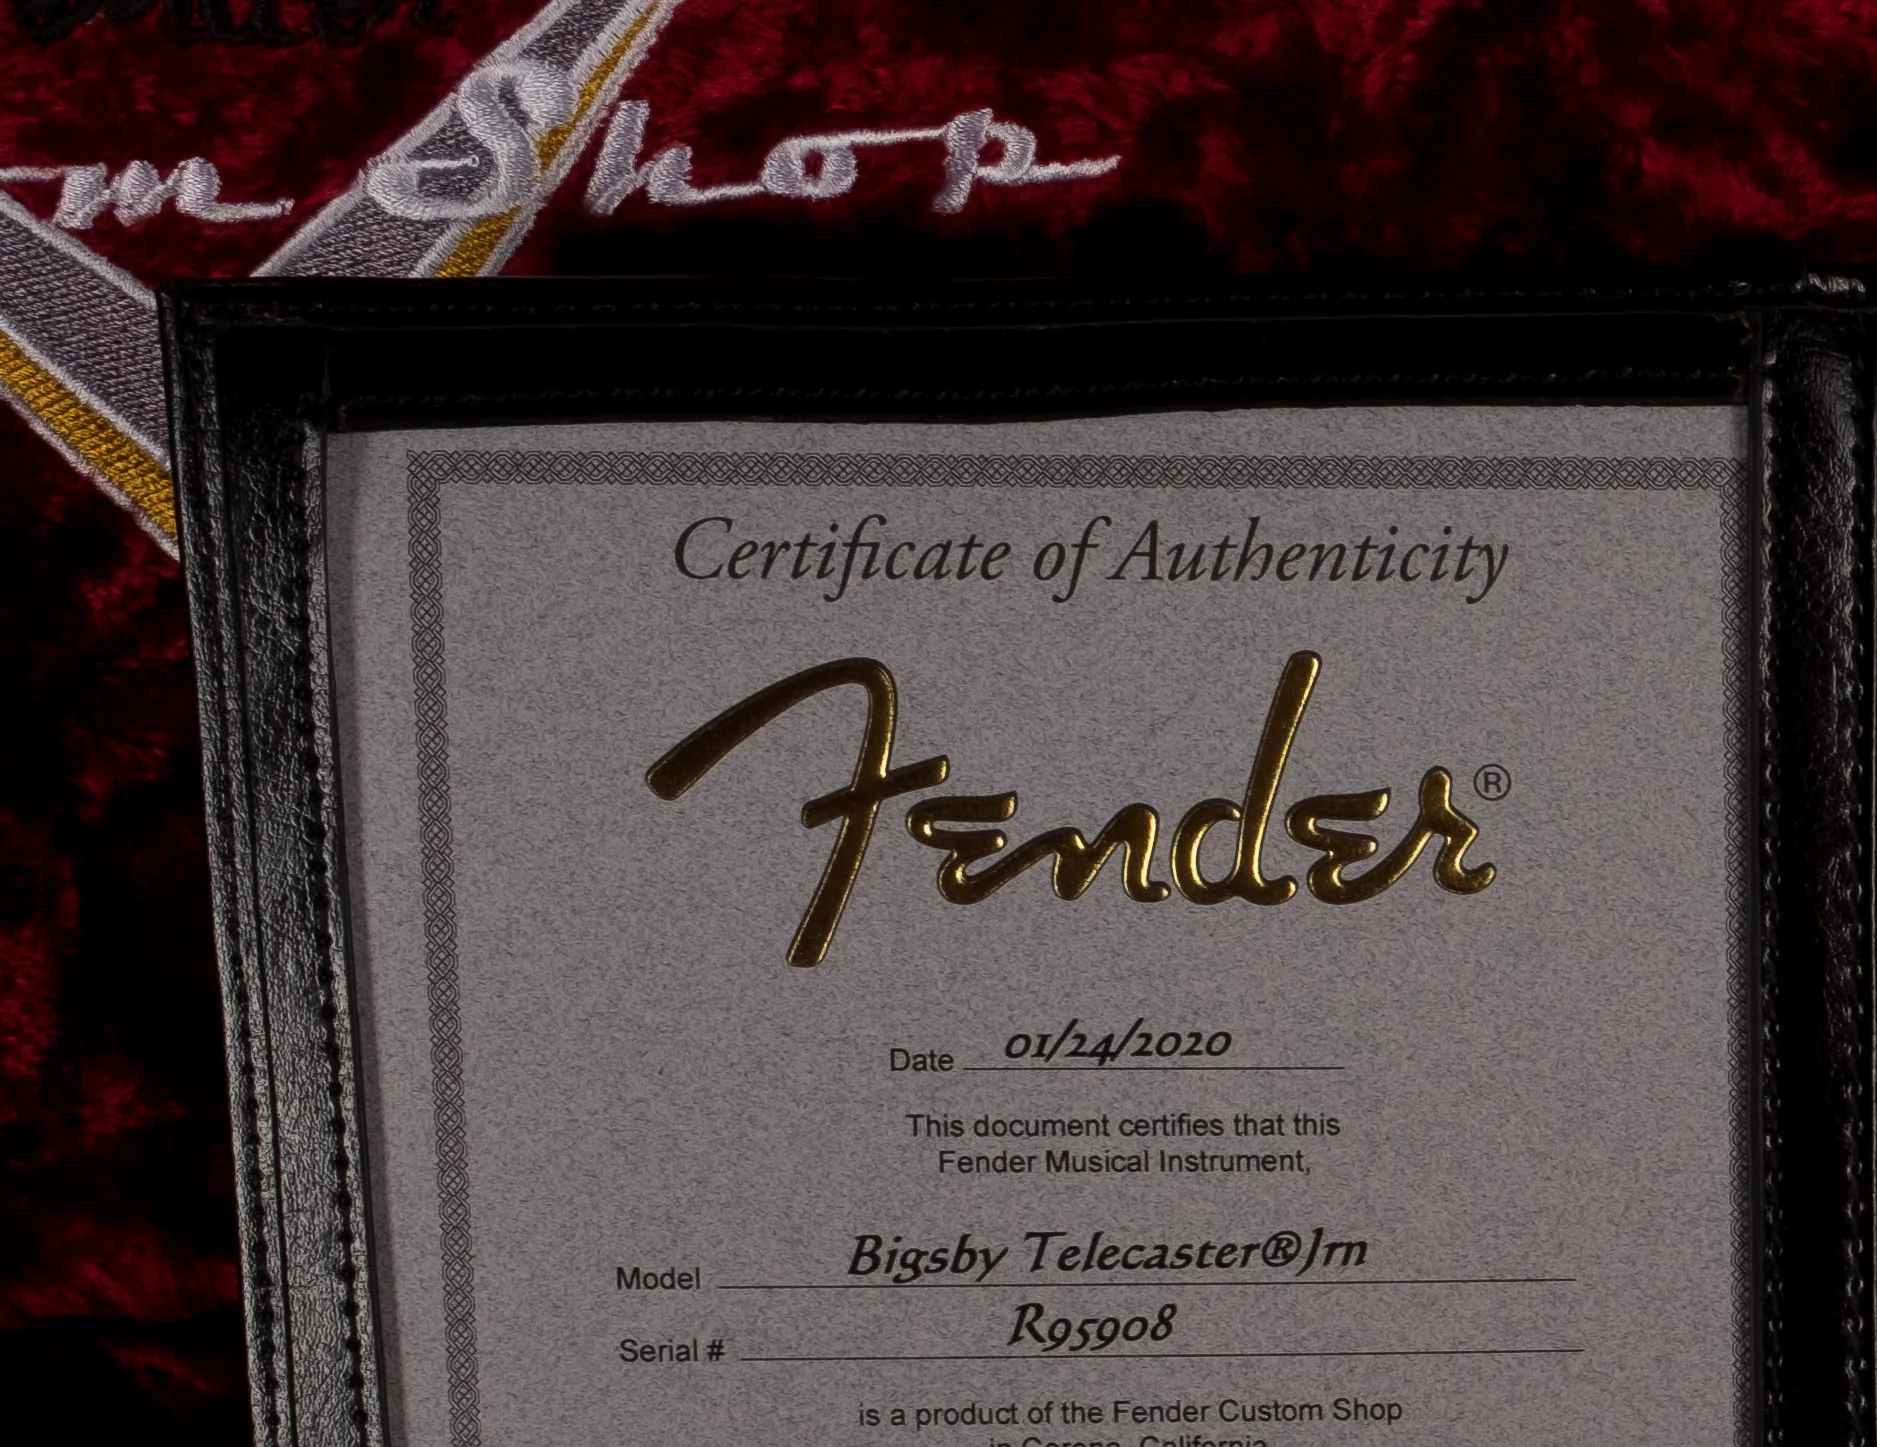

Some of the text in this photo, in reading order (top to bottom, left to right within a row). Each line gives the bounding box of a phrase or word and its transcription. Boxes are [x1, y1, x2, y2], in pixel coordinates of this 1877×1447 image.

[364, 60, 1121, 218] Shop
[674, 515, 1509, 604] Certificate of Authenticity
[890, 1018, 1232, 1072] Date 01/24/2020
[906, 1113, 1340, 1137] This document certifies that this
[940, 1150, 1310, 1174] Fender Musical Instrument,
[617, 1267, 700, 1290] Model
[847, 1232, 1007, 1282] Bigsby
[620, 1303, 1177, 1362] Serial # R95908
